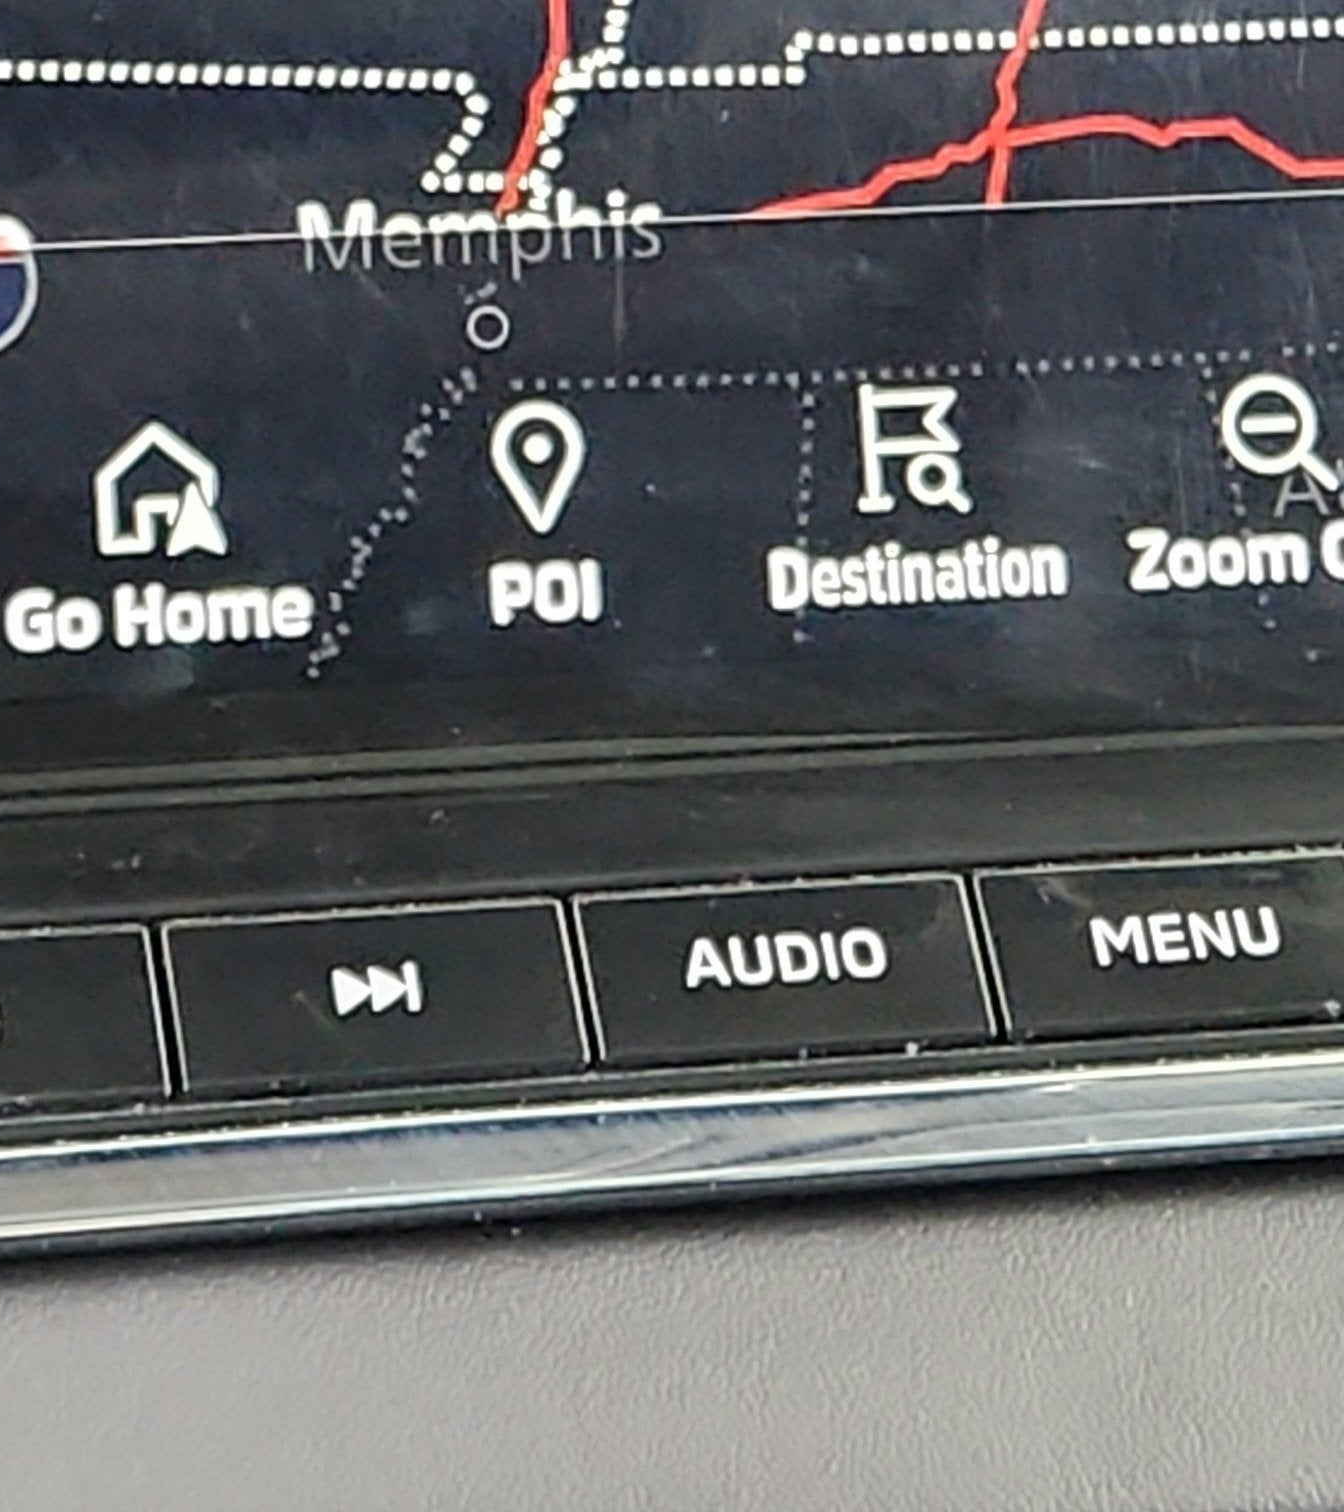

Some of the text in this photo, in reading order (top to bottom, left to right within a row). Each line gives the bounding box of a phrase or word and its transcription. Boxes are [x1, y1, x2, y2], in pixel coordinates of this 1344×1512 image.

[296, 188, 664, 282] Memphis
[766, 534, 1070, 611] Destination
[1126, 524, 1310, 591] Zoom
[4, 582, 313, 653] Go Home
[488, 559, 603, 627] POI
[684, 928, 889, 989] AUDIO
[1088, 906, 1283, 967] MENU
